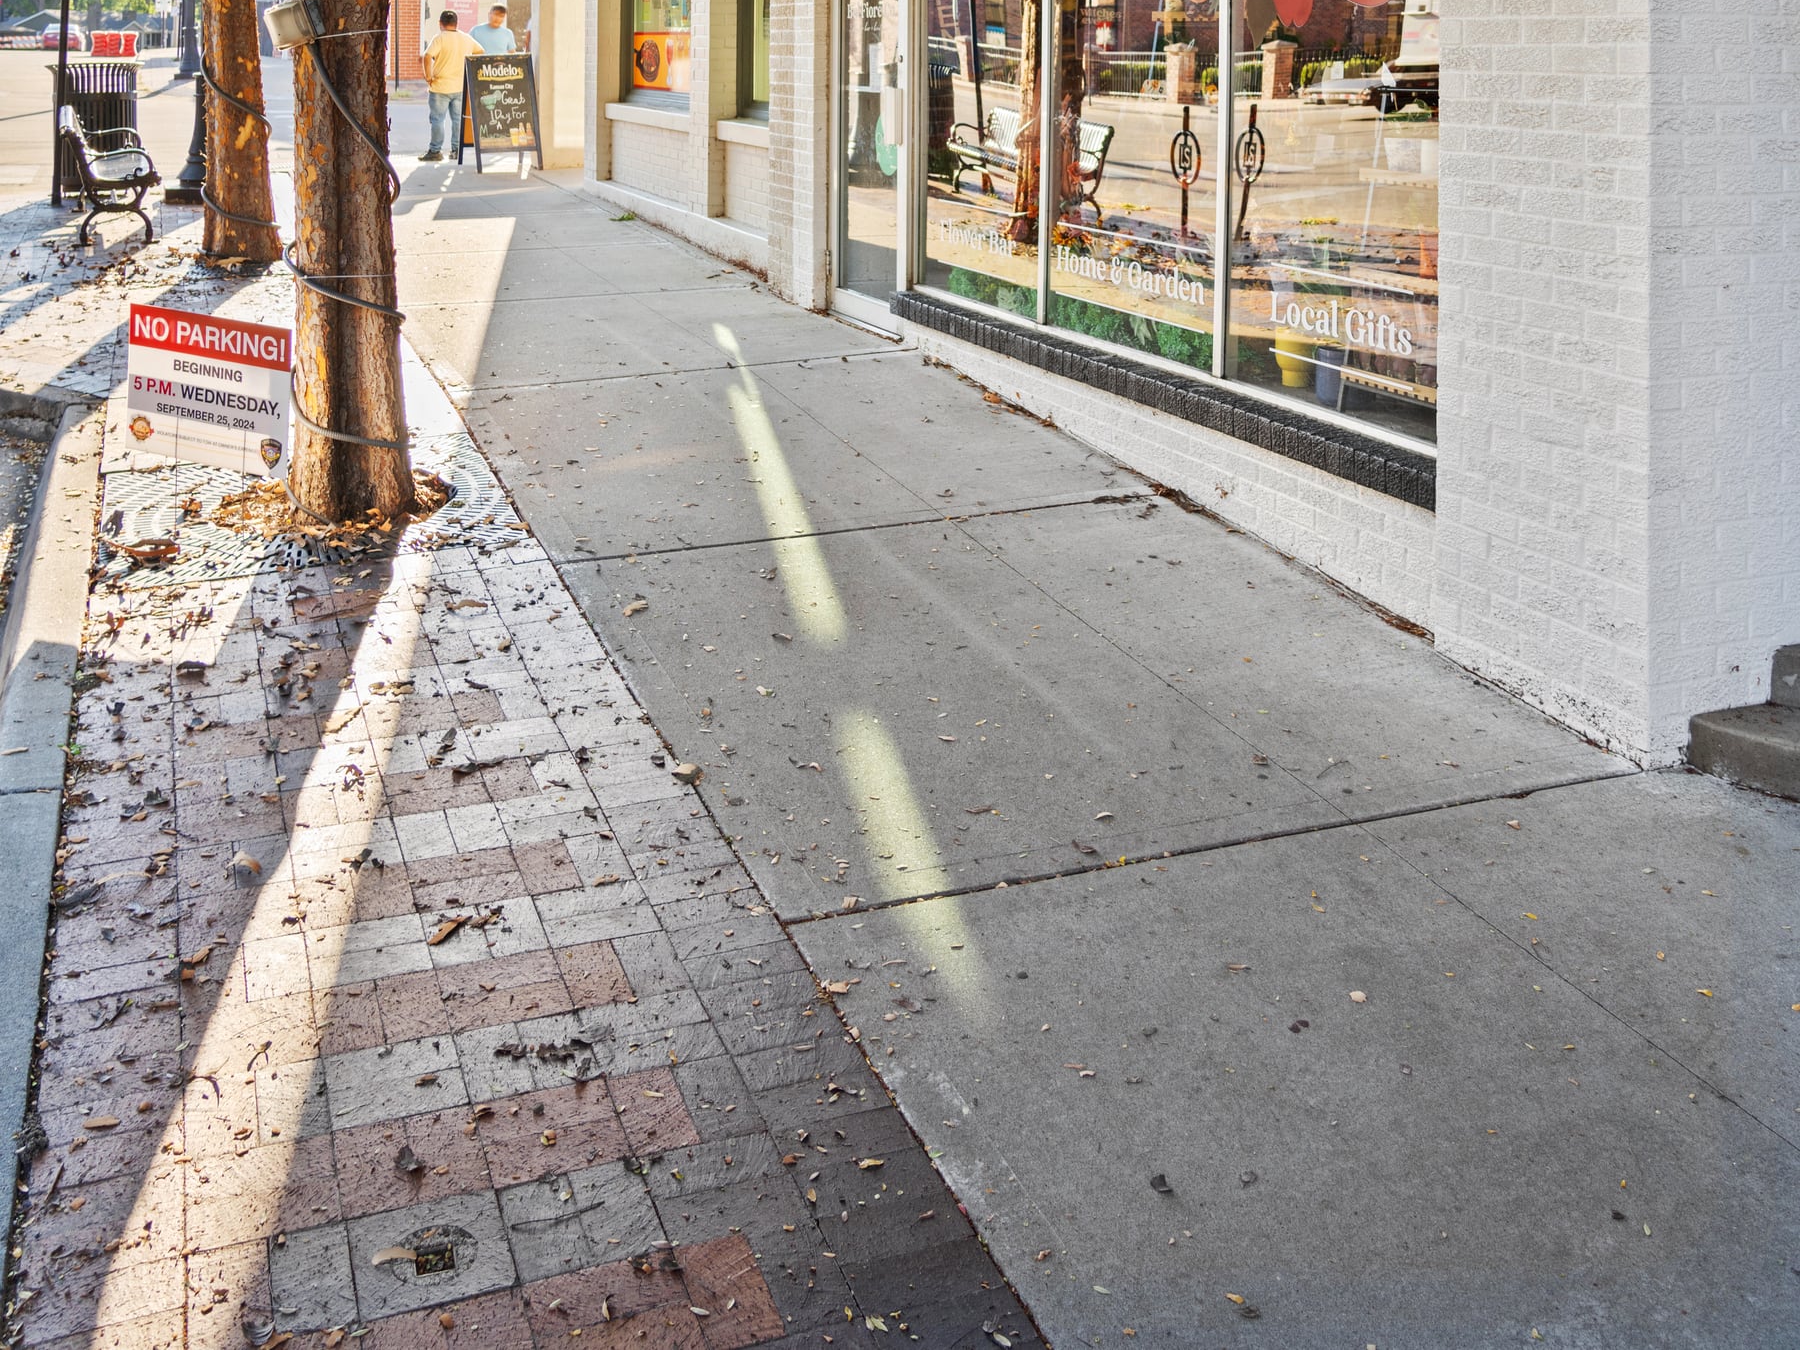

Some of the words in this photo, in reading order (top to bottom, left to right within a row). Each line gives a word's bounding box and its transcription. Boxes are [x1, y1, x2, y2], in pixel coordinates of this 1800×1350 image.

[861, 2, 882, 18] Fiore
[482, 64, 518, 77] Modelo
[939, 218, 987, 251] Flower
[988, 229, 1017, 259] Bar
[1056, 244, 1108, 282] Home
[1110, 256, 1124, 285] &
[1127, 261, 1205, 306] Garden
[134, 313, 169, 342] NO
[176, 320, 285, 363] PARKING!
[1270, 291, 1339, 339] Local
[1345, 309, 1413, 356] Gifts
[173, 359, 243, 383] BEGINNING
[133, 376, 142, 391] 5
[146, 377, 176, 397] P.M.
[181, 384, 281, 420] WEDNESDAY,
[156, 402, 214, 423] SEPTEMBER
[216, 414, 231, 428] 25,
[233, 417, 255, 430] 2024
